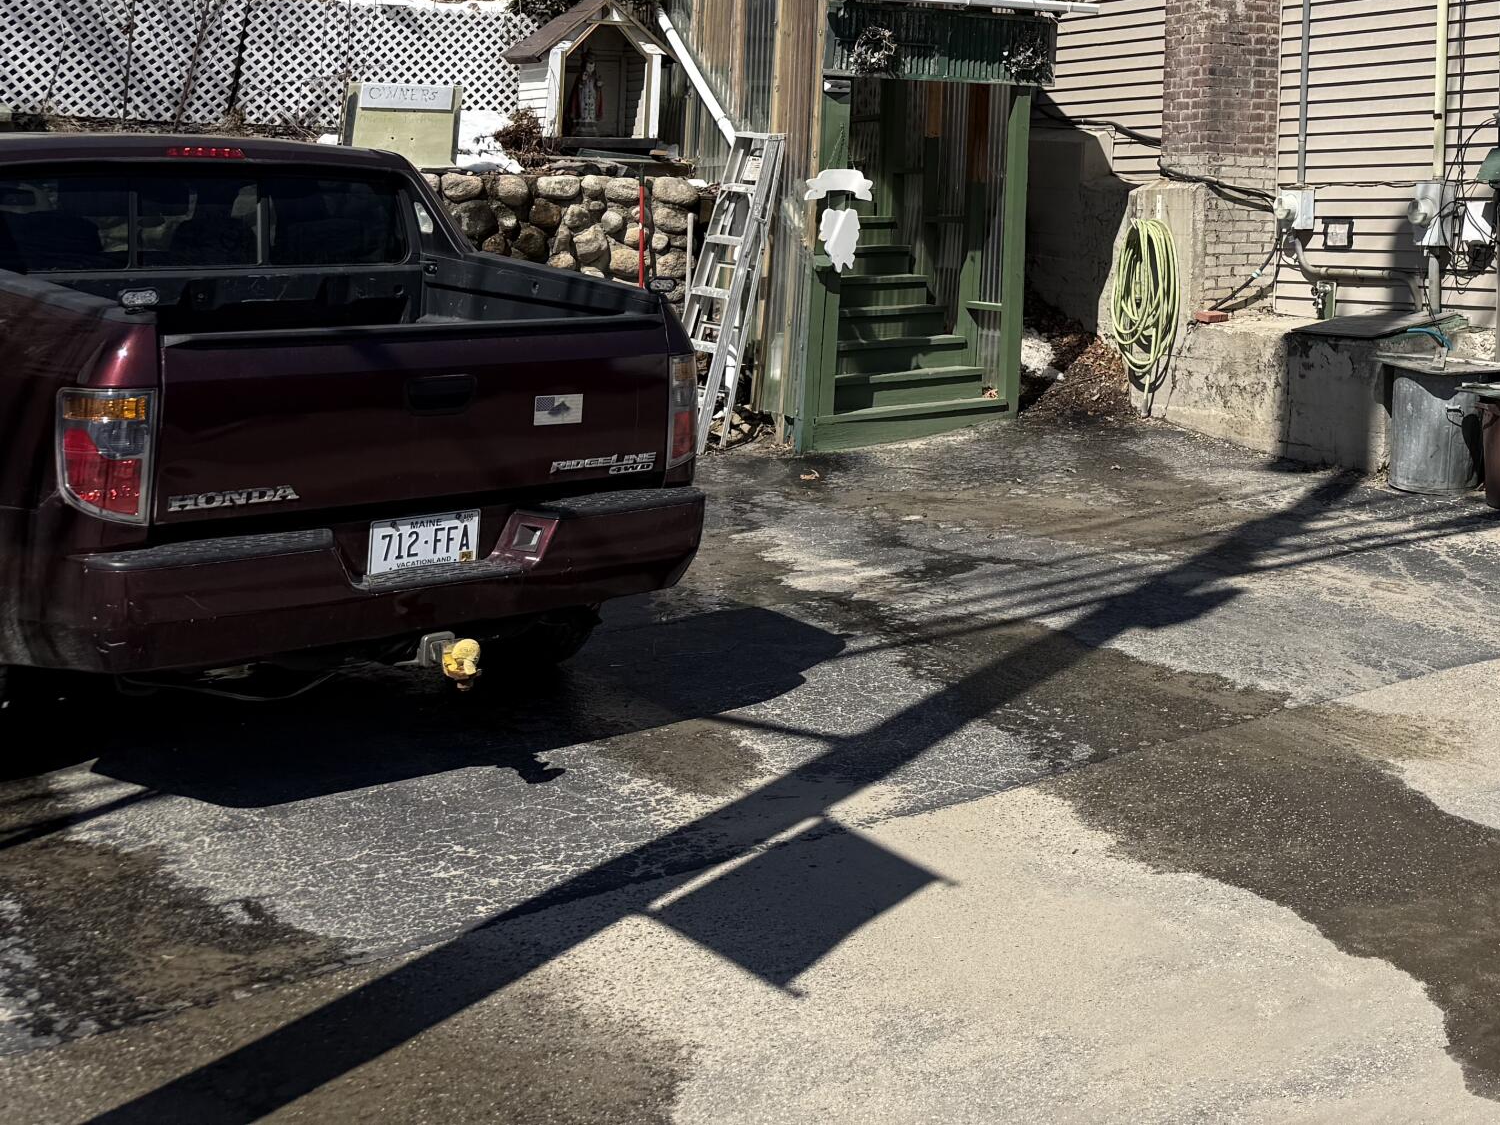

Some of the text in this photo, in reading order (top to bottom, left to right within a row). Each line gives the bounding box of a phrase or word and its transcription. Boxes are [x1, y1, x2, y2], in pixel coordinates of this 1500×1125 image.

[369, 87, 439, 102] OWNERS
[549, 452, 656, 475] RIDGELINE
[609, 462, 654, 474] 4WD
[167, 484, 300, 512] HONDA
[410, 518, 442, 530] MAINE
[396, 555, 451, 568] VACATIONLAND
